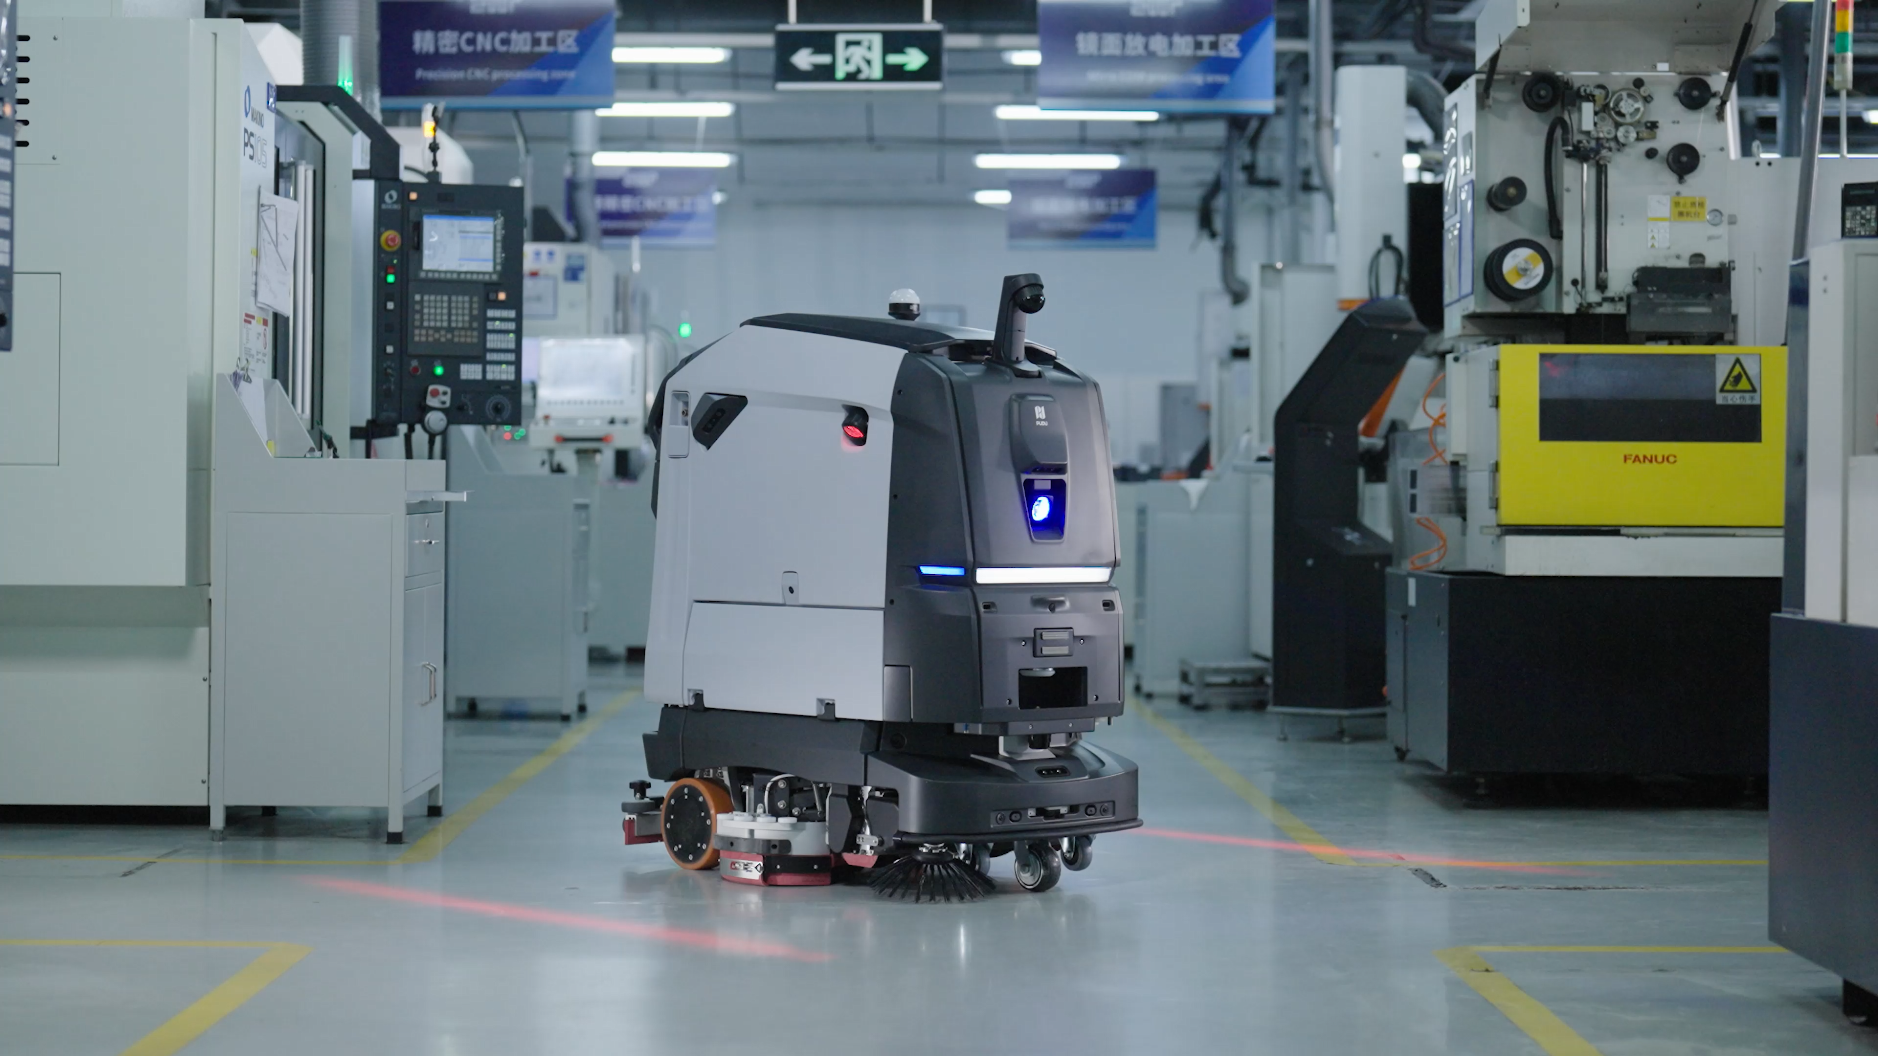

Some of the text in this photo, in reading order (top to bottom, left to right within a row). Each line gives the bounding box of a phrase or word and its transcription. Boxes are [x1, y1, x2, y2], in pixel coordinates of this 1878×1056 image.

[412, 28, 580, 55] 精密CNC加工区
[1076, 31, 1242, 58] 镜面放电加工区
[466, 67, 491, 80] CNC
[1623, 454, 1678, 464] FANUC
